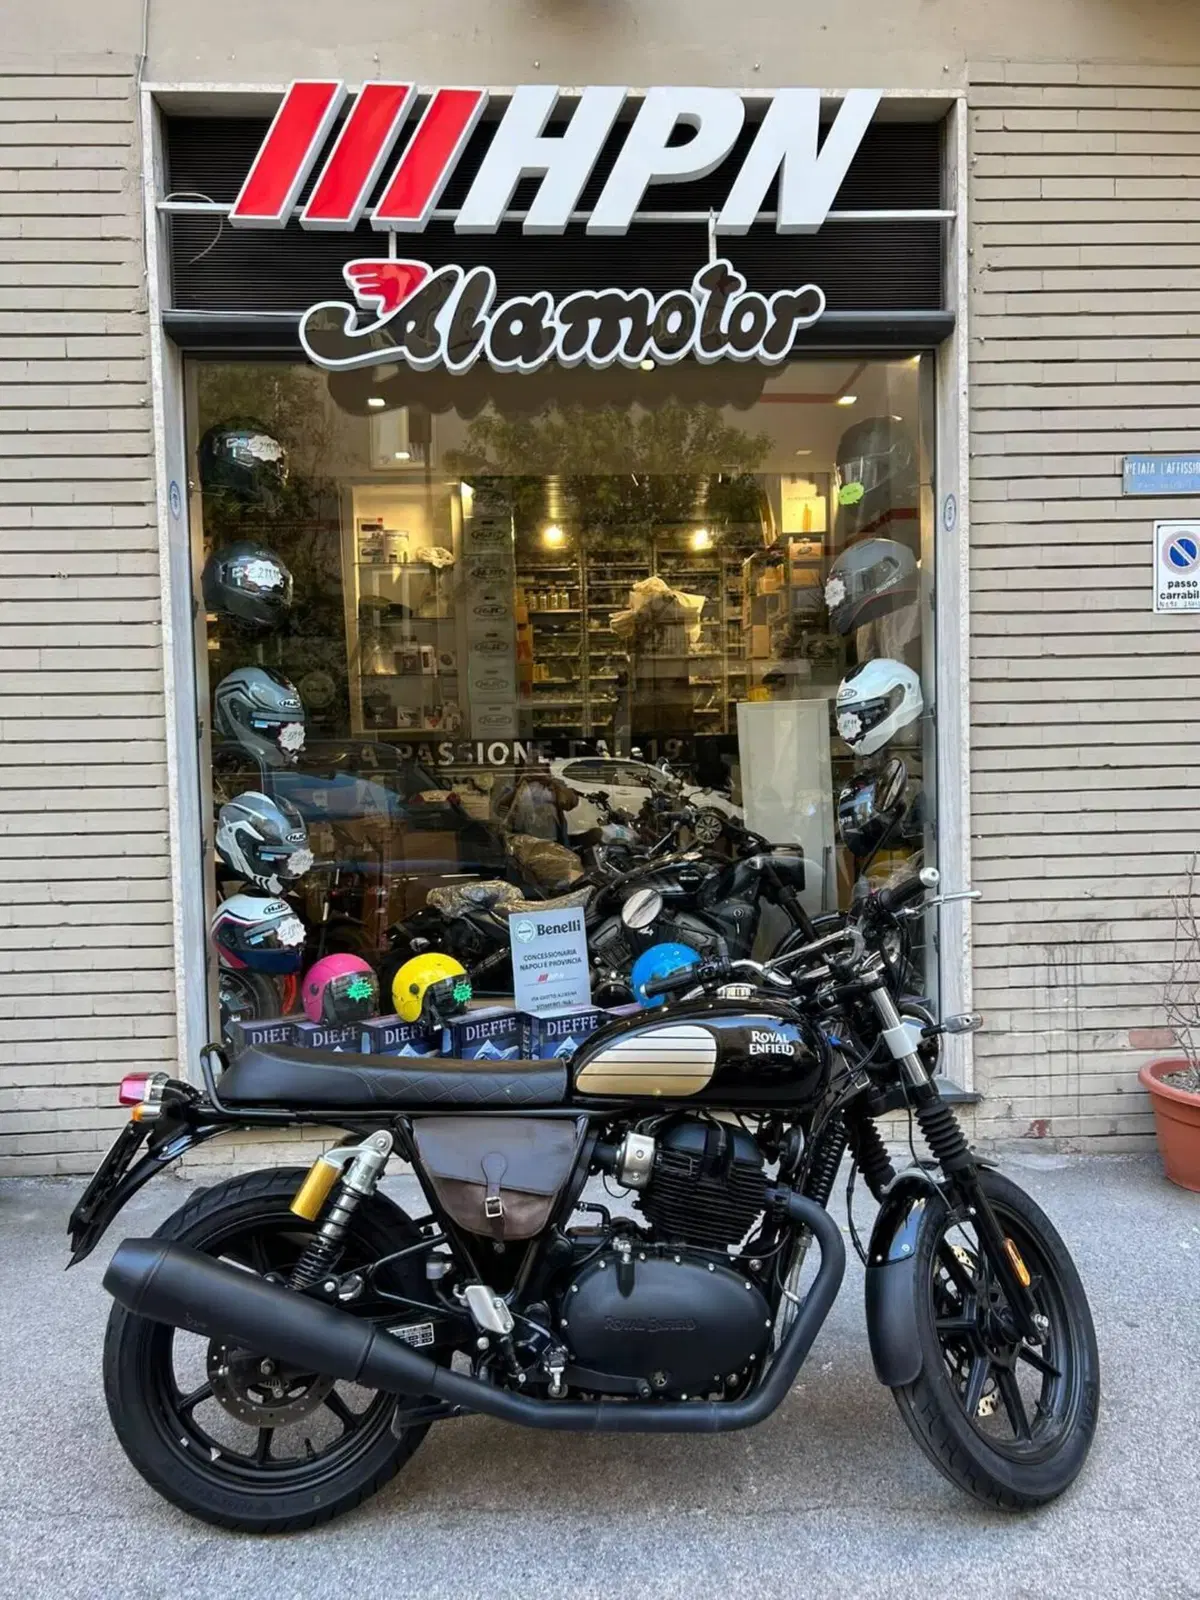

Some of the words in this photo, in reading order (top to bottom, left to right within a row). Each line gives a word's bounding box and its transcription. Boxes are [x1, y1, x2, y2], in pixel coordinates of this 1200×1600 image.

[453, 85, 883, 236] HPN
[298, 258, 828, 374] Alamotor
[1160, 461, 1200, 476] L'AFFISSIO
[1168, 580, 1198, 590] passo
[1160, 590, 1200, 600] carrabil
[267, 902, 290, 913] HJC
[536, 920, 581, 936] Benelli
[523, 949, 577, 962] CONCESSIONARIA
[520, 962, 544, 971] NAPOLI
[549, 957, 582, 968] PROVINCIA
[465, 1017, 517, 1041] DIEFFE
[546, 1015, 599, 1037] DIEFFE
[251, 1027, 291, 1045] DIEF
[751, 1030, 790, 1044] ROYAL
[749, 1043, 795, 1057] ENFIELD
